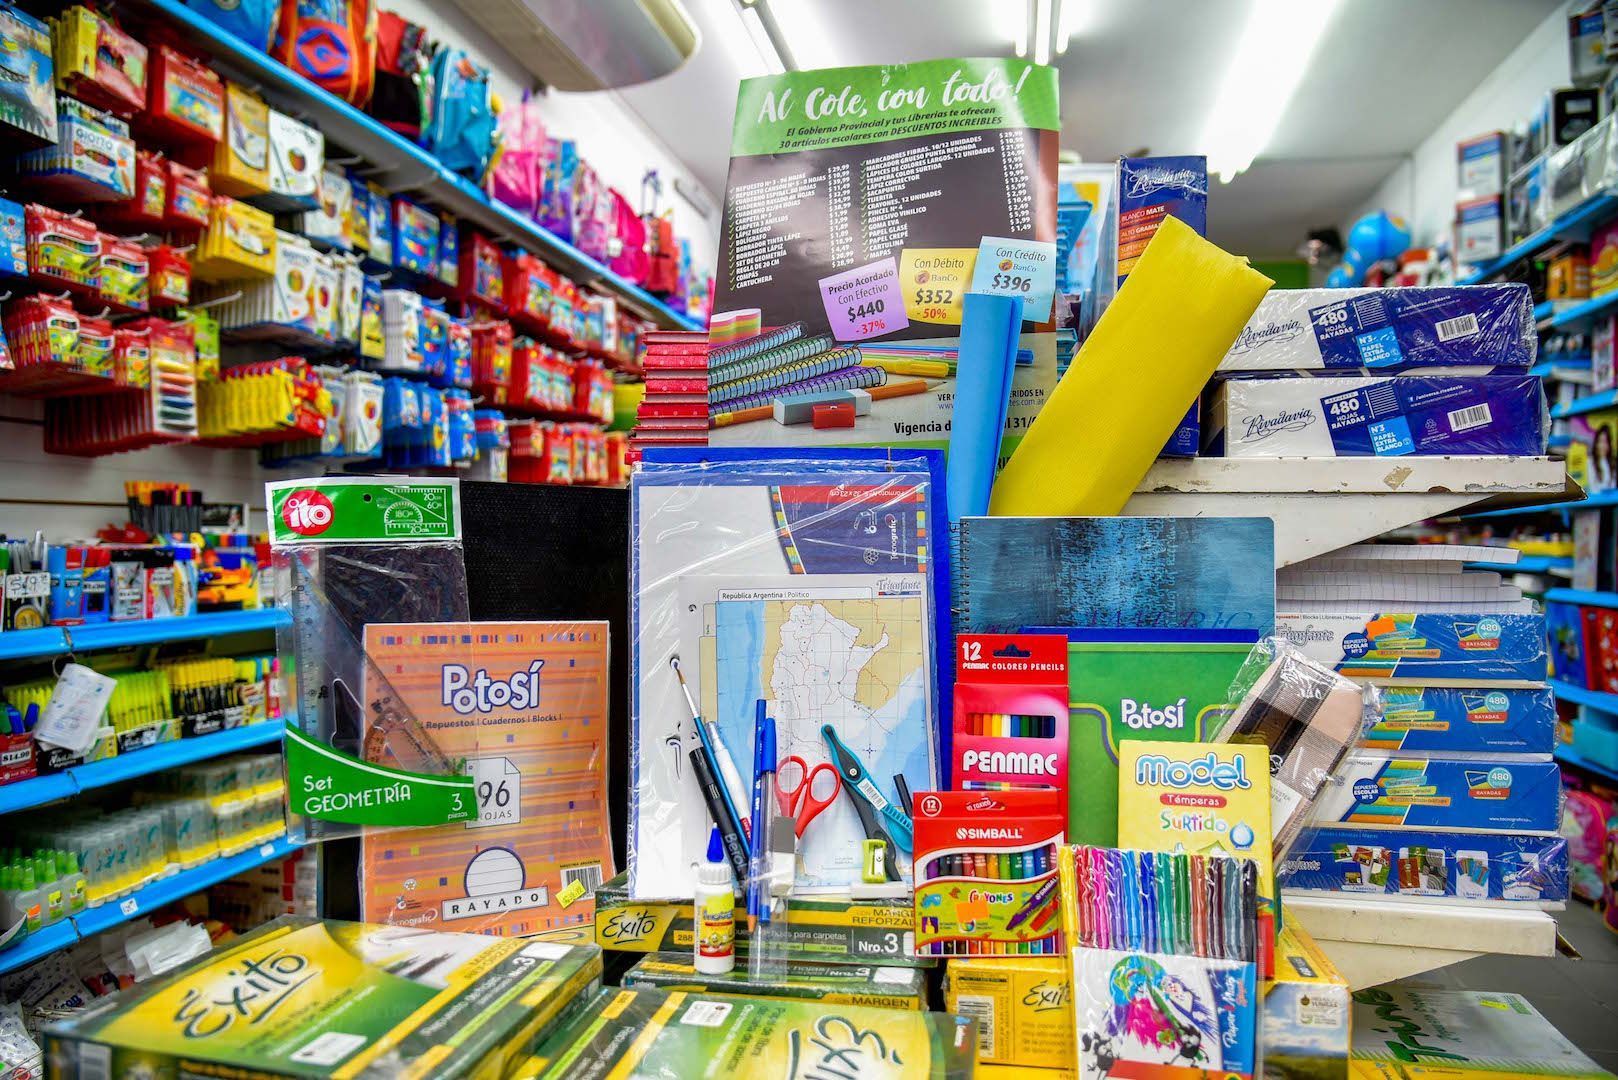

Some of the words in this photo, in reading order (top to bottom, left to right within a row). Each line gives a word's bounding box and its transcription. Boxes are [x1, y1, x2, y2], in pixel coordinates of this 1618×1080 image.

[758, 89, 792, 123] Al
[805, 85, 868, 120] Cole,
[878, 85, 930, 111] con
[786, 127, 796, 137] El
[798, 125, 838, 136] Gobierno
[839, 119, 885, 132] Provincial
[892, 117, 906, 125] tus
[950, 108, 958, 116] te
[961, 107, 996, 116] ofrecen
[75, 127, 113, 150] GIOTTO
[779, 140, 791, 149] 30
[831, 133, 872, 143] escolares
[873, 129, 888, 138] con
[890, 120, 947, 136] DESCUENTOS
[866, 152, 906, 165] MARCADORES
[950, 136, 982, 146] UNIDADES
[866, 160, 899, 171] MARCADOR
[901, 155, 924, 164] GRUESO
[925, 149, 945, 158] PUNTA
[947, 144, 976, 153] REDONDA
[900, 159, 926, 170] COLORES
[963, 147, 995, 157] UNIDADES
[896, 168, 914, 177] COLOR
[916, 163, 942, 172] SURTIDA
[885, 174, 920, 187] CORRECTOR
[867, 184, 905, 197] SACAPUNTAS
[910, 190, 941, 201] UNIDADES
[868, 193, 893, 203] TIJERITA
[868, 207, 889, 216] PINCEL
[868, 212, 898, 223] ADHESIVO
[1122, 210, 1145, 221] BLANCO
[1146, 206, 1164, 215] MATE
[869, 229, 887, 237] PAPEL
[869, 236, 888, 244] PAPEL
[870, 240, 904, 251] CARTULINA
[870, 250, 891, 258] MAPAS
[996, 248, 1012, 258] Con
[1015, 248, 1046, 261] Crédito
[736, 266, 753, 274] REGLA
[914, 259, 931, 268] Con
[934, 259, 964, 268] Débito
[737, 275, 772, 288] CARTUCHERA
[829, 280, 854, 295] Precio
[855, 268, 893, 287] Acordado
[992, 273, 1031, 292] $396
[838, 292, 854, 305] Con
[856, 283, 888, 300] Efectivo
[915, 288, 952, 305] $352
[848, 299, 884, 322] $440
[1319, 310, 1347, 326] 480
[1320, 327, 1353, 340] RAYADAS
[1325, 323, 1346, 332] HOJAS
[1229, 320, 1304, 355] Rivadavia
[1362, 343, 1383, 352] PAPEL
[1364, 350, 1384, 358] EXTRA
[1365, 353, 1390, 363] BLANCO
[1330, 399, 1359, 416] 480
[1332, 416, 1365, 429] RAYADAS
[1337, 412, 1359, 422] HOJAS
[894, 421, 941, 435] Vigencia
[1241, 408, 1316, 443] Rivadavia
[1374, 433, 1395, 442] PAPEL
[1375, 437, 1397, 447] EXTRA
[1377, 442, 1402, 452] BLANCO
[288, 498, 331, 528] ito
[890, 519, 898, 560] Tecnografic
[722, 592, 752, 600] República
[962, 642, 982, 661] 12
[442, 660, 544, 714] Potosí
[1121, 698, 1187, 729] Potosí
[426, 720, 475, 730] Repuestos
[482, 716, 526, 726] Cuadernos
[532, 715, 557, 723] Blocks
[962, 749, 1058, 776] PENMAC
[303, 775, 333, 792] Set
[1491, 773, 1509, 781] 480
[304, 782, 411, 815] GEOMETRÍA
[478, 780, 510, 808] 96
[1167, 794, 1220, 806] Témperas
[452, 793, 463, 811] 3
[448, 812, 467, 821] piezas
[968, 829, 1022, 839] SIMBALL
[725, 833, 748, 870] Berol
[451, 893, 539, 915] RAYADO
[677, 933, 693, 941] 288
[793, 932, 811, 941] para
[813, 931, 847, 941] carpetas
[851, 997, 910, 1008] MARGEN
